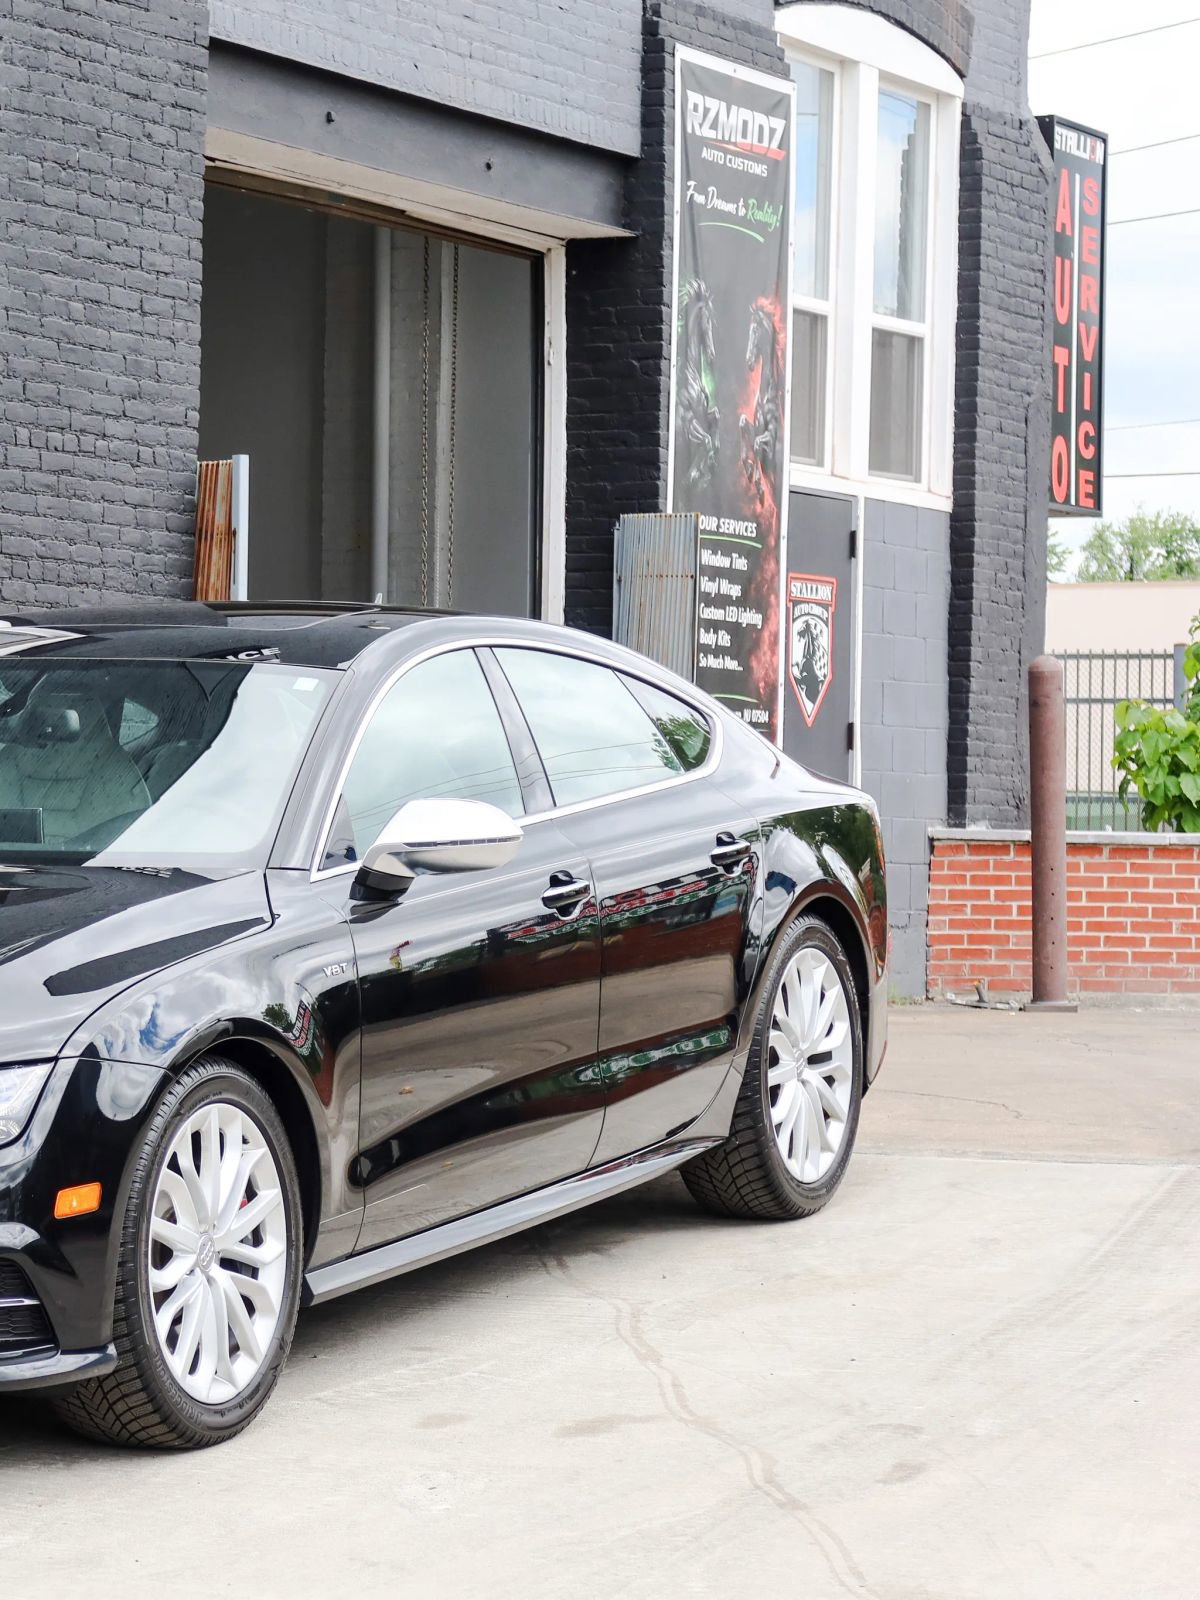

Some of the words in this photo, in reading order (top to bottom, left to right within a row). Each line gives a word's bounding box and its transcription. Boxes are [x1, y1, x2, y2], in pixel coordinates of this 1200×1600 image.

[686, 89, 786, 161] RZMODZ
[1054, 125, 1105, 166] STALLION
[701, 146, 725, 165] AUTO
[726, 154, 768, 177] CUSTOMS
[686, 180, 706, 205] From
[706, 186, 737, 215] Dreams
[738, 197, 747, 216] to
[1051, 168, 1072, 504] AUTO
[1077, 176, 1098, 508] SERVICE
[699, 515, 718, 531] OUR
[719, 517, 757, 538] SERVICES
[701, 548, 731, 568] Window
[731, 552, 748, 571] Tints
[700, 575, 719, 598] Vinyl
[719, 577, 742, 601] Wraps
[791, 582, 832, 601] STALLION
[700, 602, 725, 621] Custom
[725, 605, 738, 622] LED
[738, 606, 763, 630] Lighting
[700, 627, 718, 649] Body
[717, 629, 731, 647] Kits
[699, 652, 707, 668] So
[707, 653, 724, 669] Much
